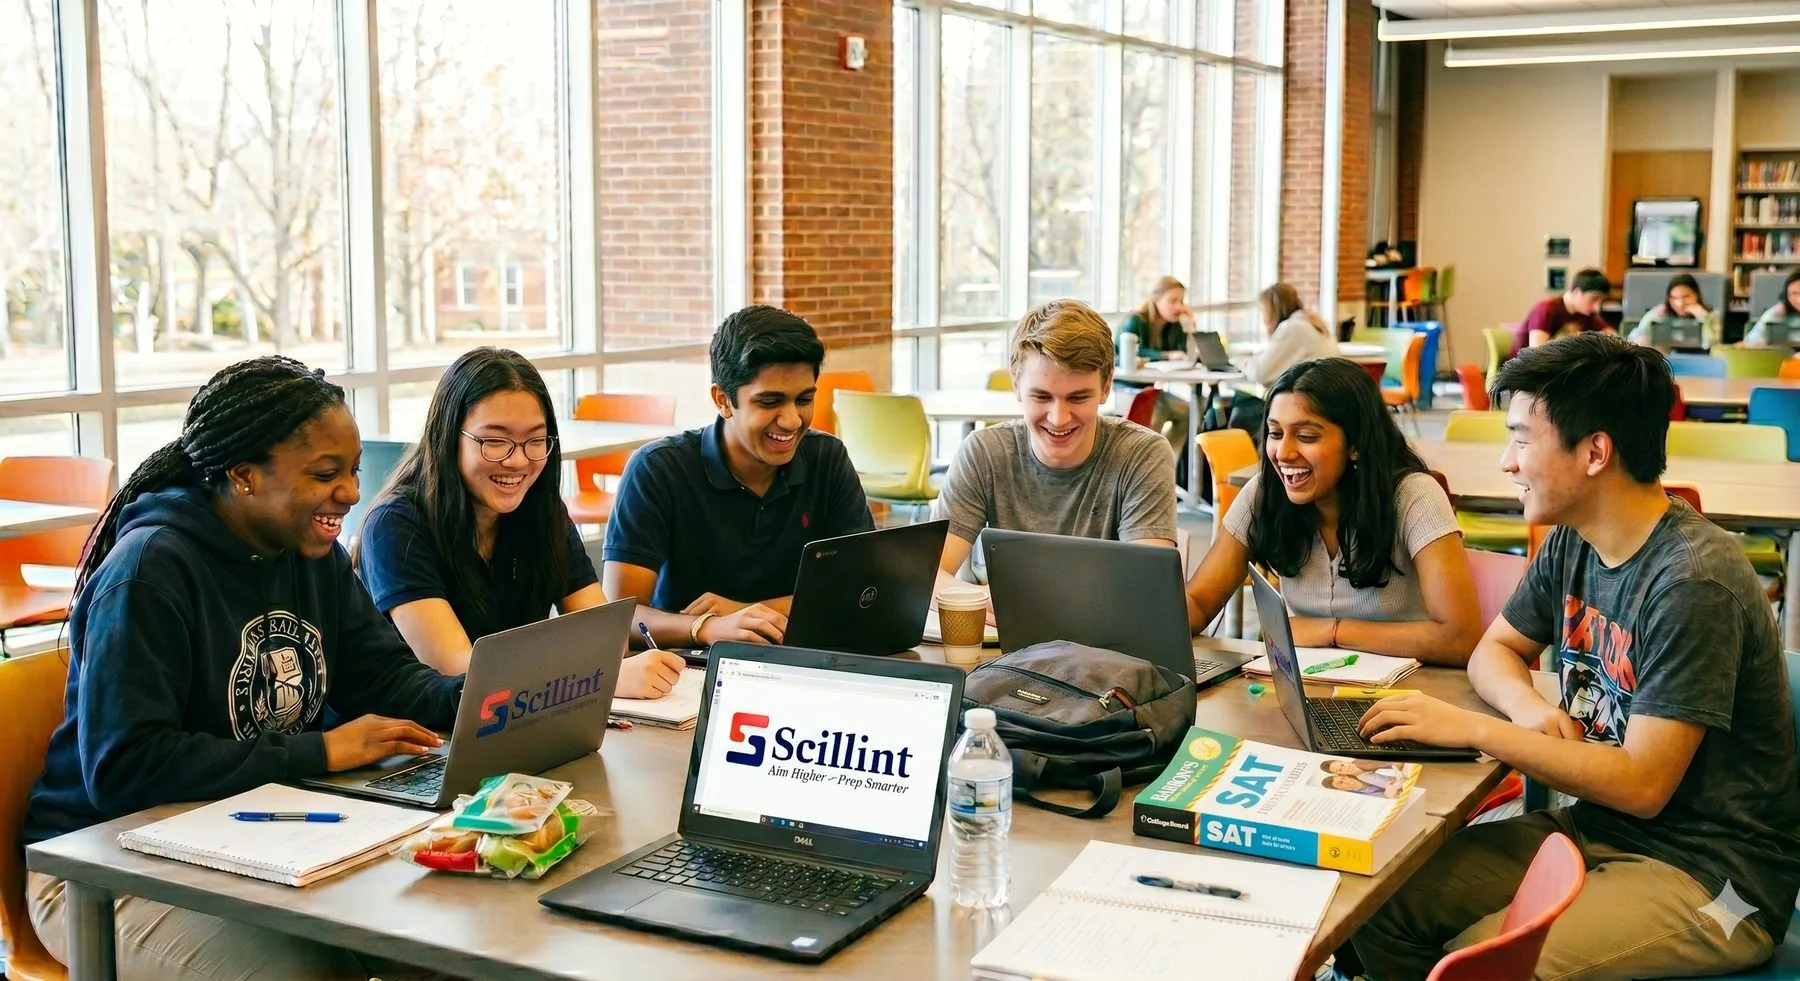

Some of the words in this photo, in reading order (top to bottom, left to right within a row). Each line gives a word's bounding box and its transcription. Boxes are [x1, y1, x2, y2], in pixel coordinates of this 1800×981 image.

[511, 668, 604, 720] Scillint
[771, 727, 913, 778] Scillint
[768, 765, 789, 777] Aim
[791, 768, 827, 783] Higher
[838, 774, 863, 789] Prep
[864, 777, 909, 794] Smarter
[1215, 754, 1284, 809] SAT
[1206, 820, 1257, 848] SAT
